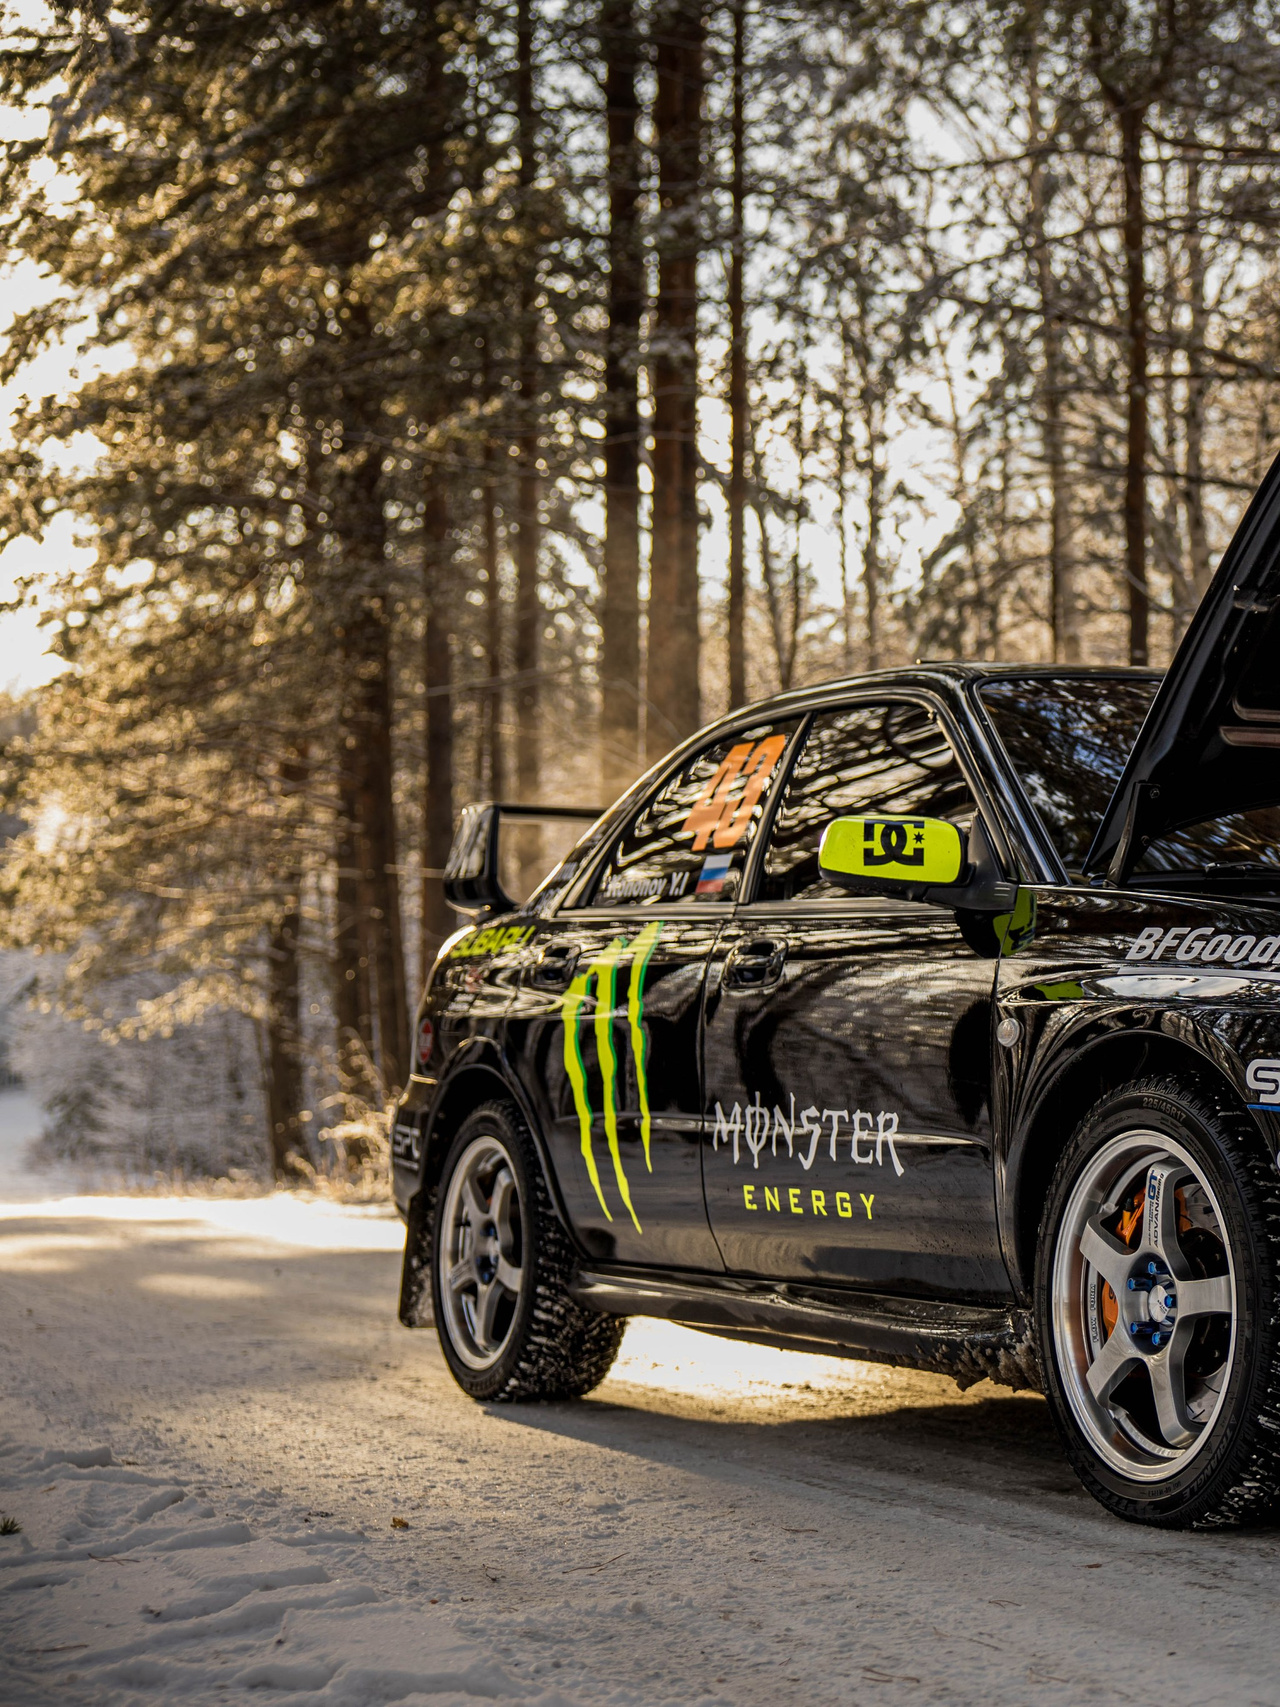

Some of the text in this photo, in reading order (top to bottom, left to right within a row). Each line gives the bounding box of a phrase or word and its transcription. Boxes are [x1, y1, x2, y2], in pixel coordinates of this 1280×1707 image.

[681, 734, 786, 851] 43
[863, 819, 925, 866] DC
[450, 925, 537, 959] SUBARU
[1142, 1097, 1186, 1122] 225/45R17
[713, 1091, 904, 1176] MONSTER
[743, 1185, 875, 1220] ENERGY
[1148, 1170, 1158, 1200] GT
[1183, 1428, 1233, 1499] TRIANGLE
